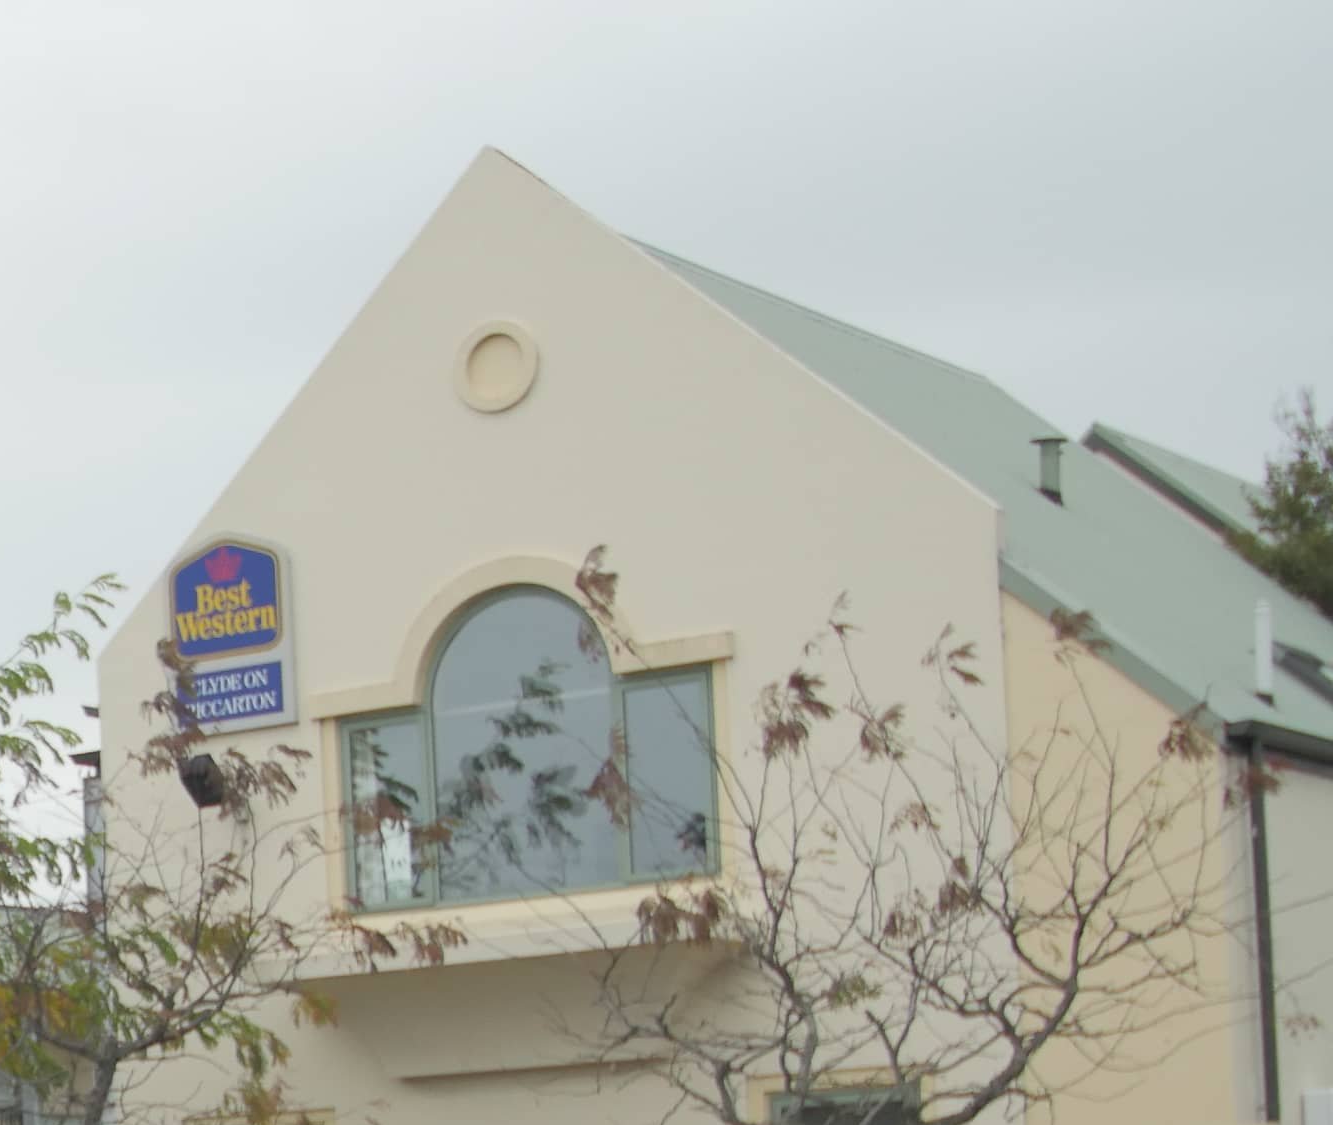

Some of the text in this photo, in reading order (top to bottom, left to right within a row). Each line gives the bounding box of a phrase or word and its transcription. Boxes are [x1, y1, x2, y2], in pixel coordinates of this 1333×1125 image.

[195, 578, 251, 615] Best
[176, 605, 277, 642] Western
[243, 668, 268, 689] ON
